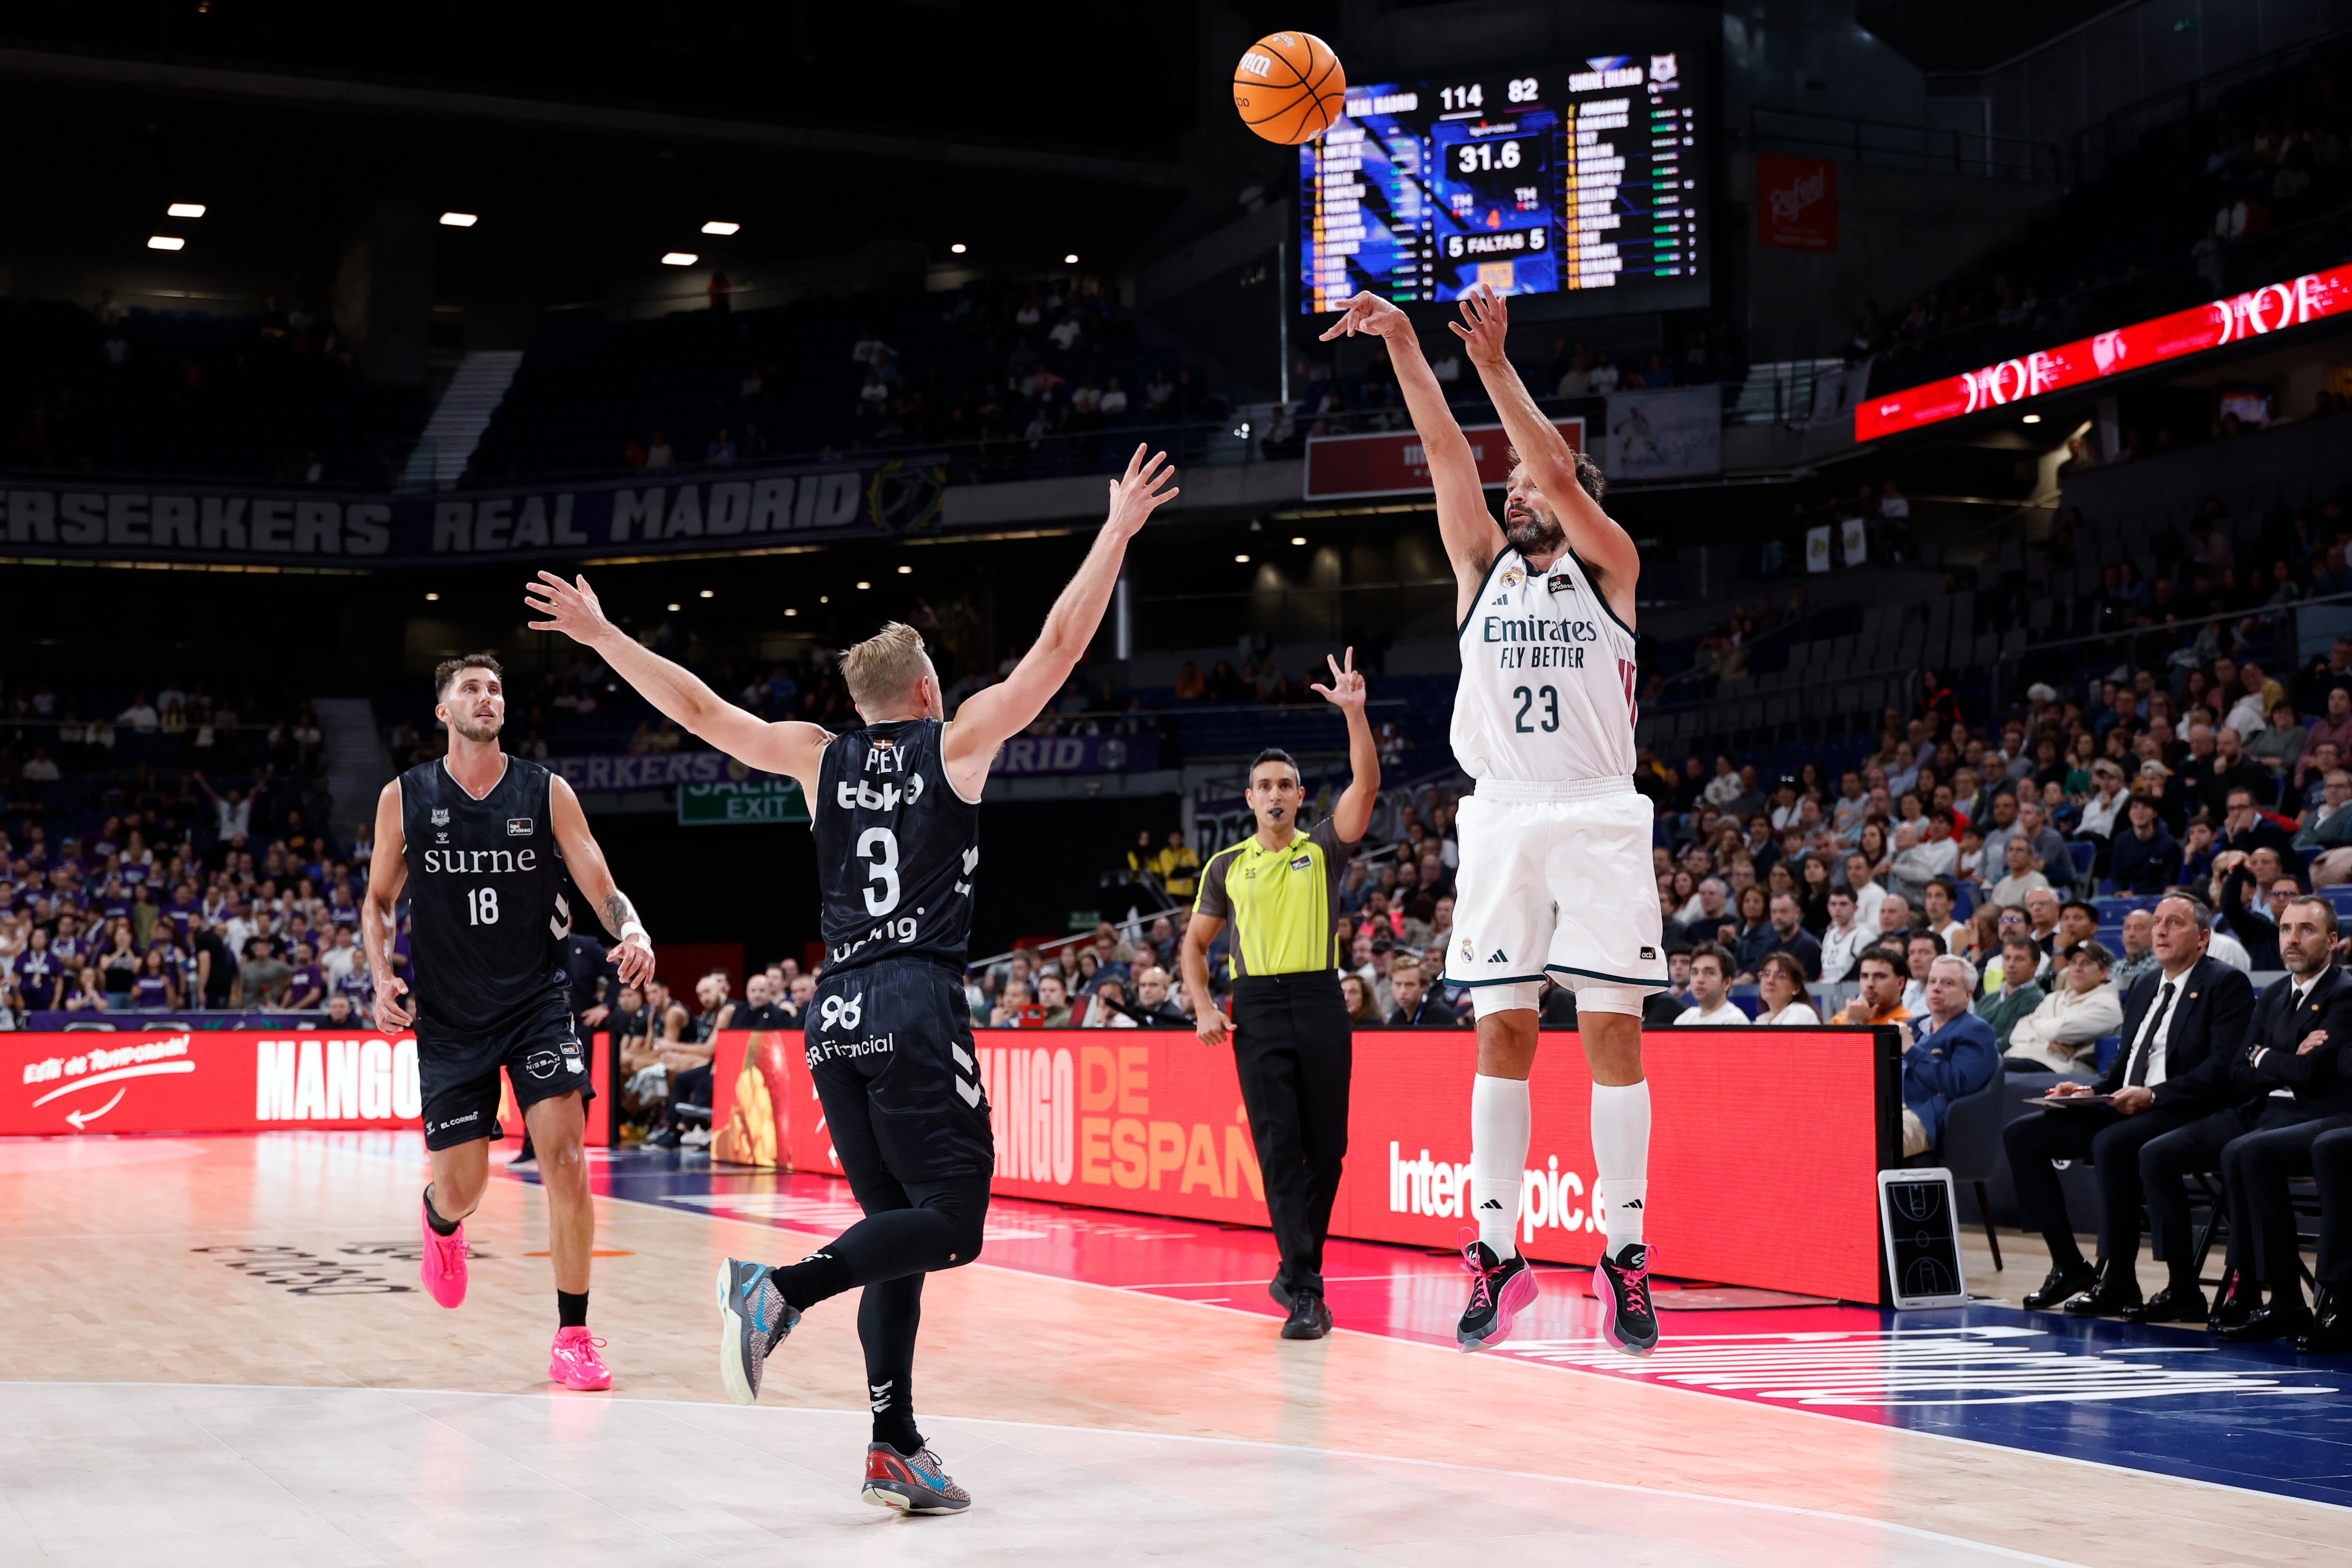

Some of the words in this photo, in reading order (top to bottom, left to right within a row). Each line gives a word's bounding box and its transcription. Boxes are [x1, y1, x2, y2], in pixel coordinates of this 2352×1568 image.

[1440, 83, 1484, 110] 114
[1508, 78, 1539, 103] 82
[1459, 141, 1521, 173] 31.6
[1486, 208, 1501, 230] 4
[1448, 236, 1464, 258] 5
[1467, 233, 1525, 254] FALTAS
[1529, 227, 1545, 250] 5
[0, 489, 391, 555] RSERKERS
[432, 494, 588, 554] REAL
[610, 472, 862, 543] MADRID
[1551, 583, 1574, 592] endesa
[1484, 614, 1597, 642] Emirates
[1501, 648, 1525, 668] FLY
[1531, 647, 1584, 668] BETTER
[1513, 685, 1559, 733] 23
[727, 797, 789, 818] EXIT
[424, 849, 537, 873] surne
[857, 827, 900, 917] 3
[468, 887, 499, 926] 18
[1641, 950, 1654, 959] acb
[526, 1055, 560, 1071] NISSAN
[256, 1039, 422, 1121] MANGO
[1081, 1046, 1149, 1115] DE
[450, 1114, 477, 1125] CORREO
[1081, 1103, 1266, 1202] ESPAÑ
